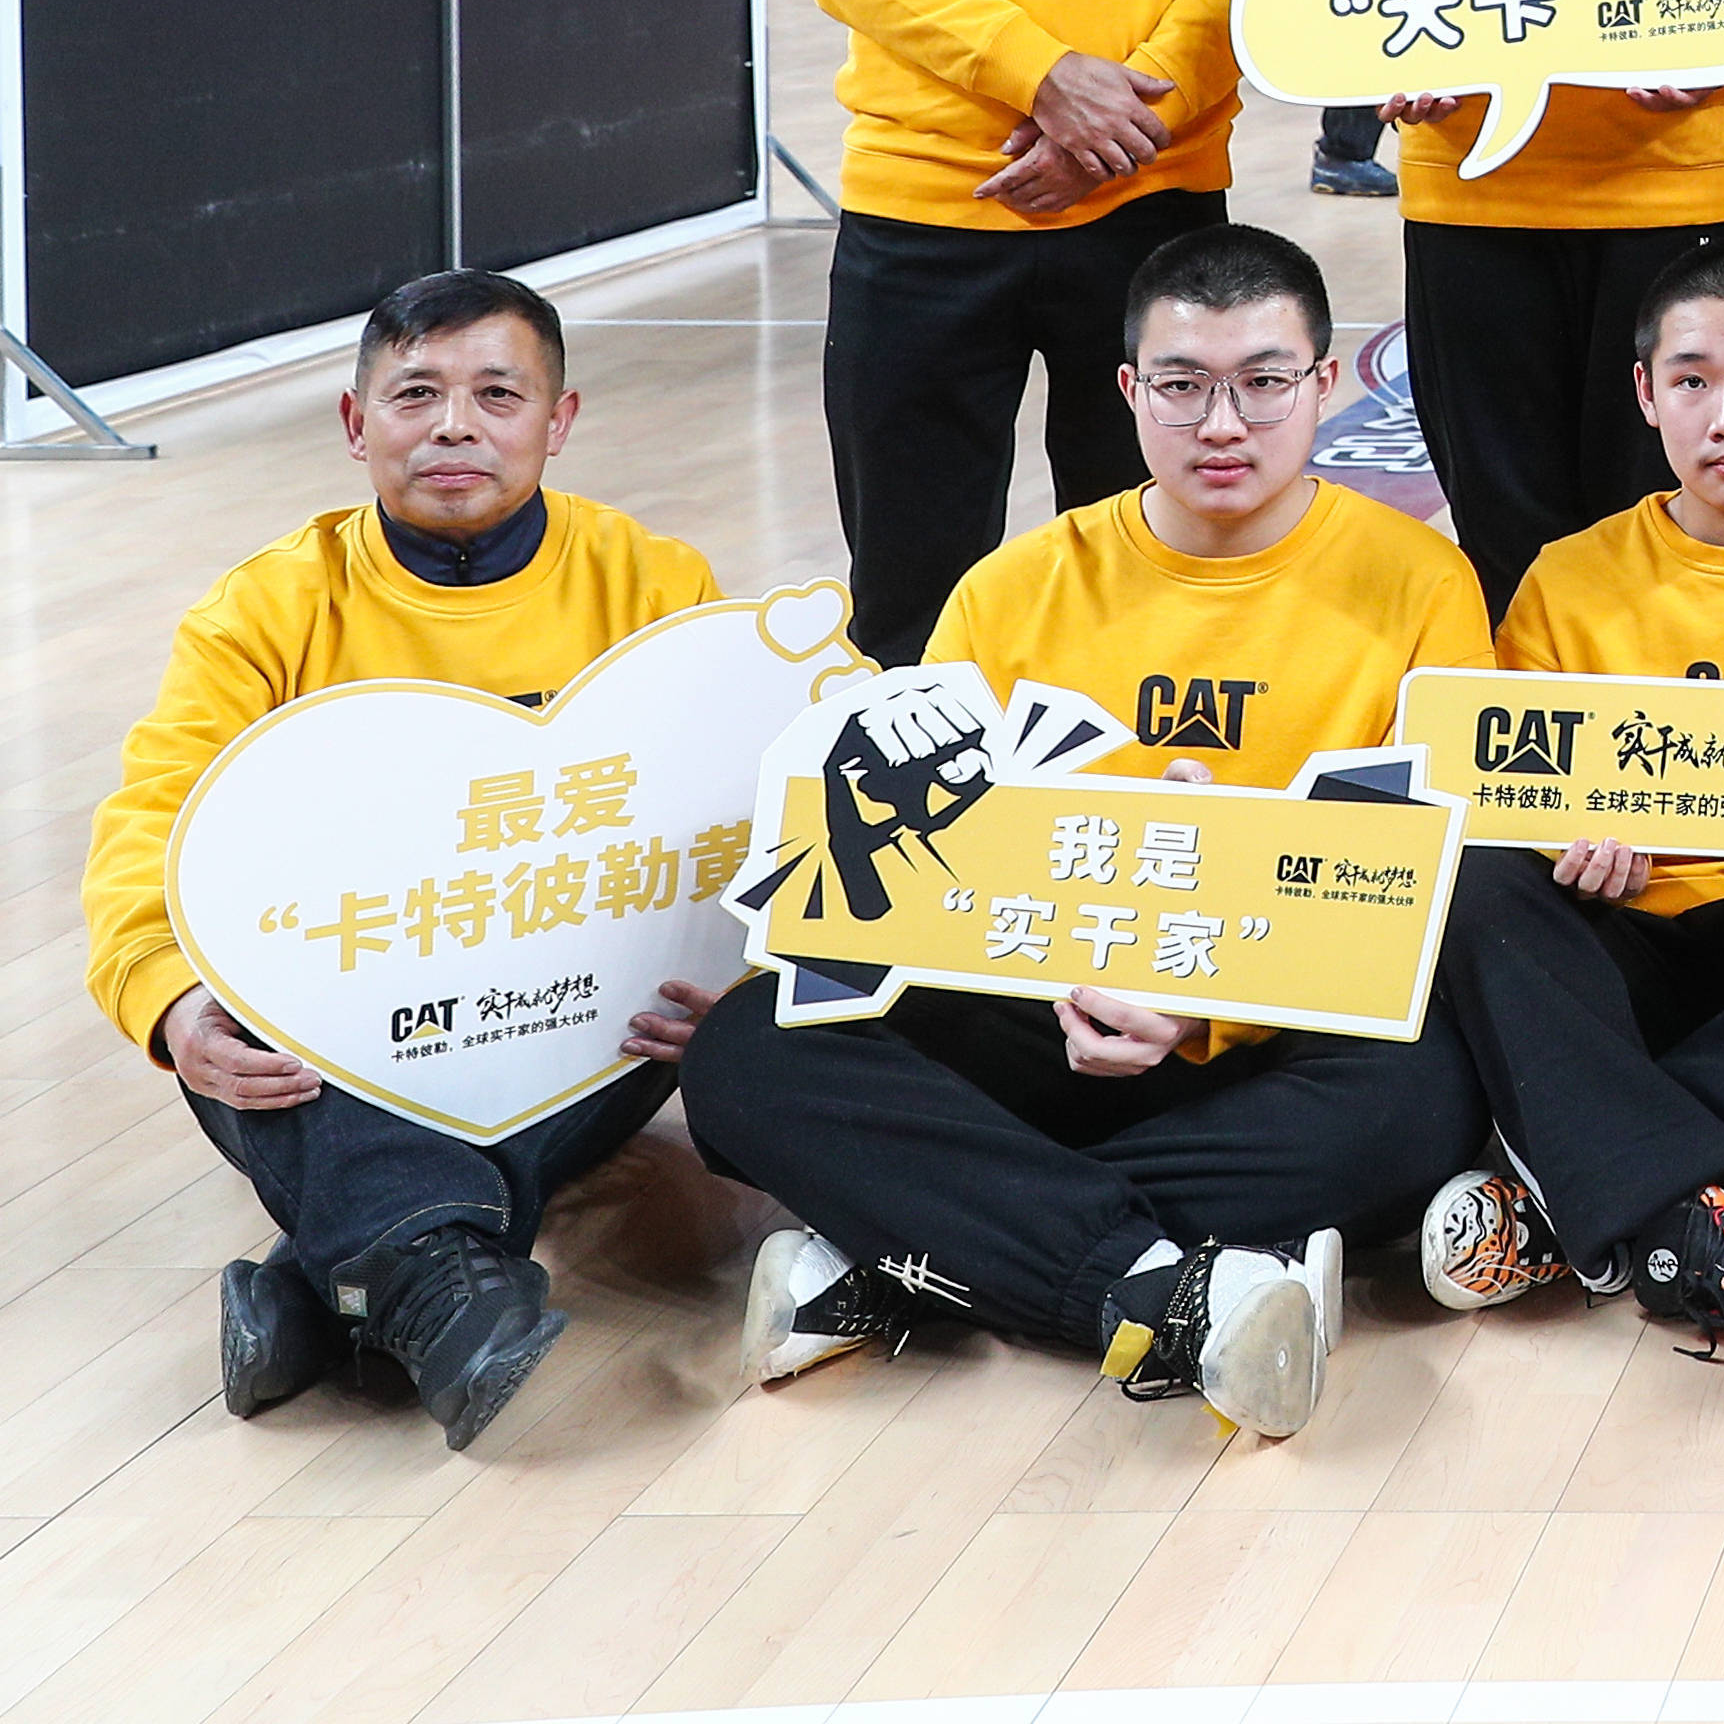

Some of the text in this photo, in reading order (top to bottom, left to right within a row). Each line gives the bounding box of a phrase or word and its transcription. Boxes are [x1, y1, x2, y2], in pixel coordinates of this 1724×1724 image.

[1136, 674, 1268, 751] CAT
[1475, 706, 1586, 776] CAT
[455, 752, 640, 854] 最爱
[1047, 813, 1203, 893] 我是
[1276, 854, 1324, 884] CAT
[941, 889, 1271, 980] “实干家”
[391, 995, 461, 1043] CAT
